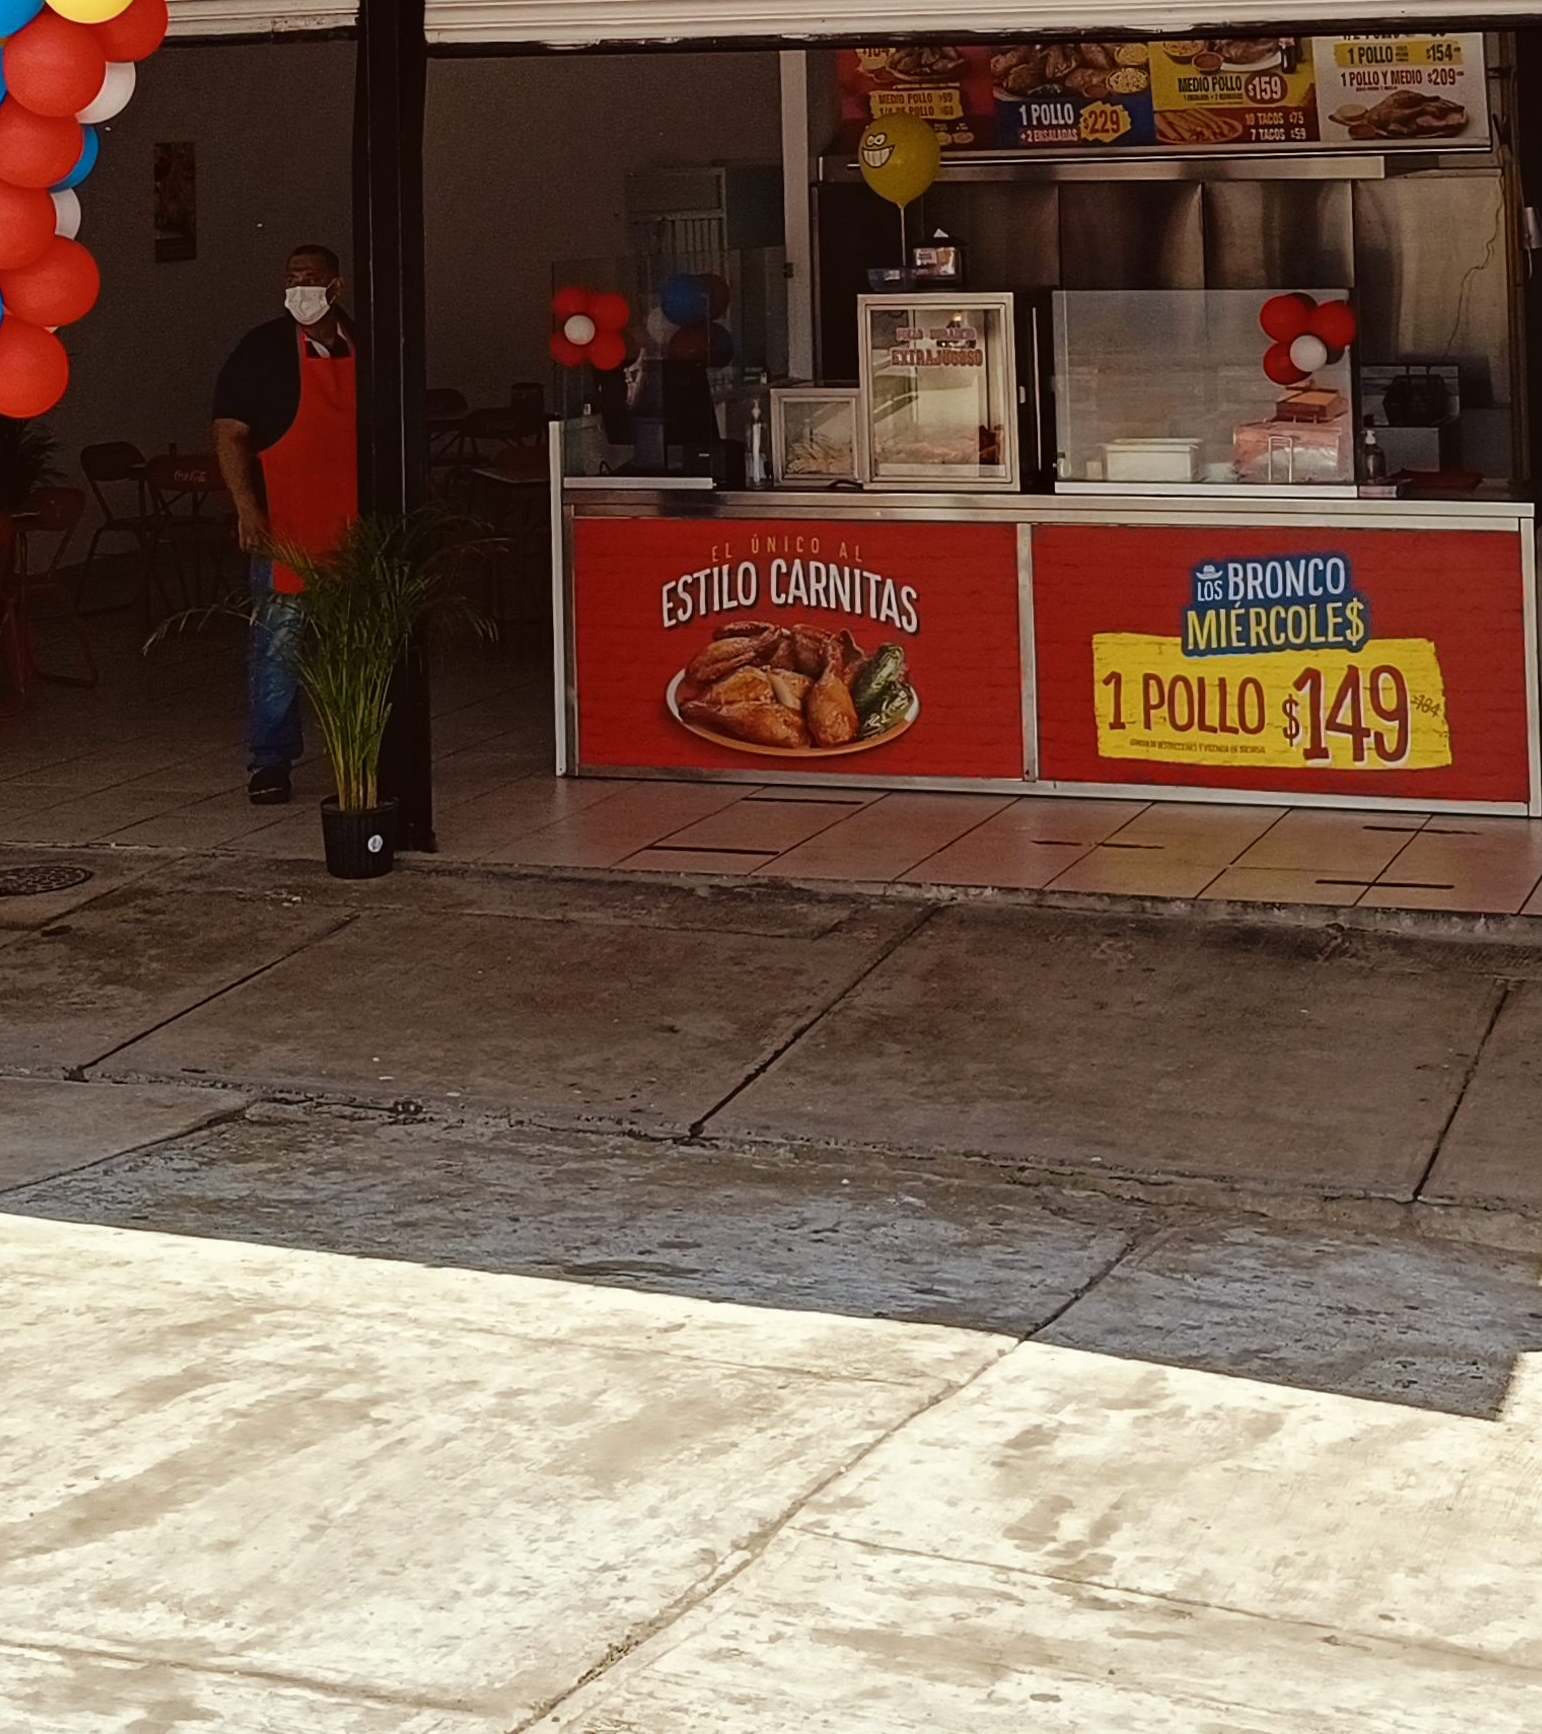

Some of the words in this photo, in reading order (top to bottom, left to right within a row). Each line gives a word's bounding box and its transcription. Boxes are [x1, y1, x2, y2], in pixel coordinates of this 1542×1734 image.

[1348, 47, 1354, 65] 1
[1358, 45, 1394, 64] POLLO
[1178, 76, 1210, 93] MEDIO
[1211, 75, 1242, 92] POLLO
[1247, 75, 1282, 100] $159
[1340, 71, 1347, 87] 1
[1349, 70, 1379, 87] POLLO
[1382, 70, 1389, 85] Y
[1391, 69, 1423, 86] MEDIO
[878, 93, 905, 105] MEDIO
[907, 92, 933, 104] POLLO
[1019, 104, 1027, 126] 1
[1031, 102, 1074, 126] POLLO
[1082, 109, 1121, 134] $229
[1259, 128, 1286, 141] TACOS
[712, 543, 732, 563] EL
[751, 534, 820, 555] ÚNICO
[839, 542, 862, 563] AL
[1197, 580, 1223, 602] LOS
[1227, 557, 1346, 602] BRONCO
[661, 561, 757, 628] ESTILO
[770, 558, 918, 634] CARNITAS
[1102, 671, 1126, 731] 1
[1142, 672, 1265, 735] POLLO
[1281, 664, 1410, 763] $149
